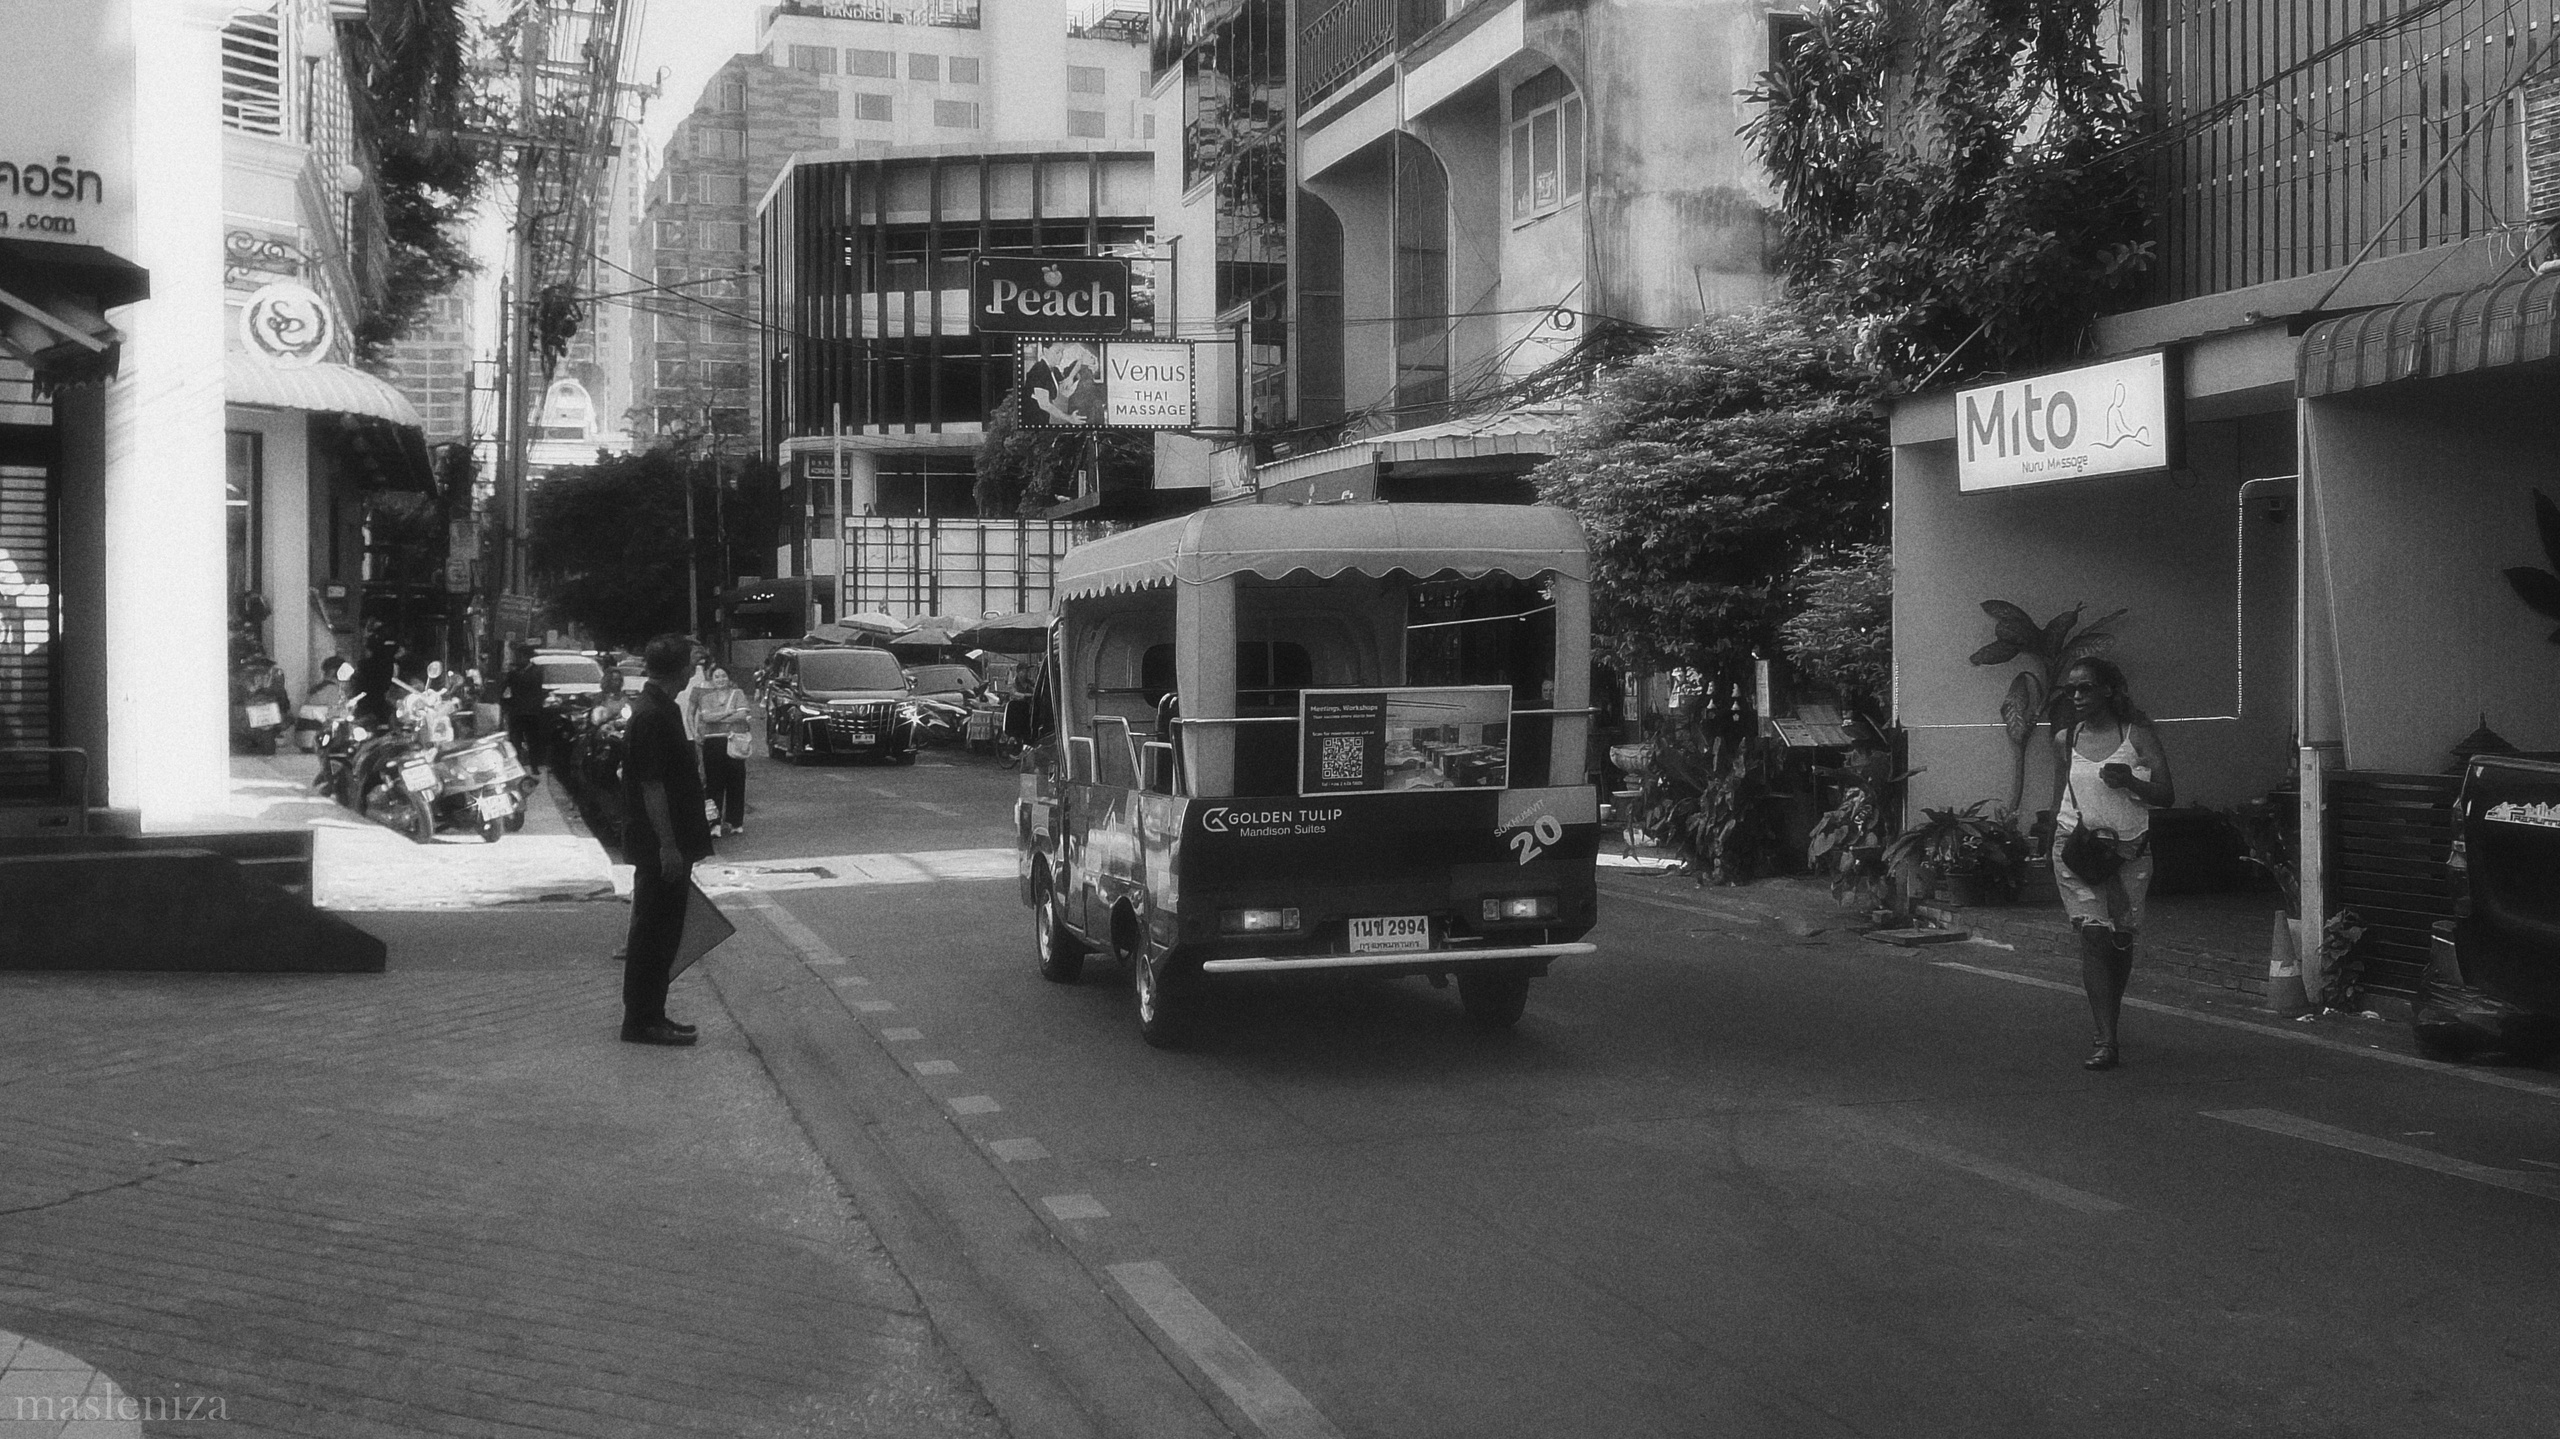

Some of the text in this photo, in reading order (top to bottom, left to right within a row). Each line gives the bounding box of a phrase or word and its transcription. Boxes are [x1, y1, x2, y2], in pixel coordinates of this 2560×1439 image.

[985, 278, 1117, 317] Peach
[1111, 358, 1186, 382] Venus
[1134, 390, 1168, 402] THAI
[1116, 404, 1187, 416] MASSAGE
[1965, 383, 2078, 463] Mito
[2022, 462, 2044, 474] Nuru
[1229, 808, 1343, 824] GOLDEN TULIP
[1240, 824, 1327, 838] Mandison Suites
[1510, 814, 1563, 866] 20
[1388, 918, 1426, 936] 2994
